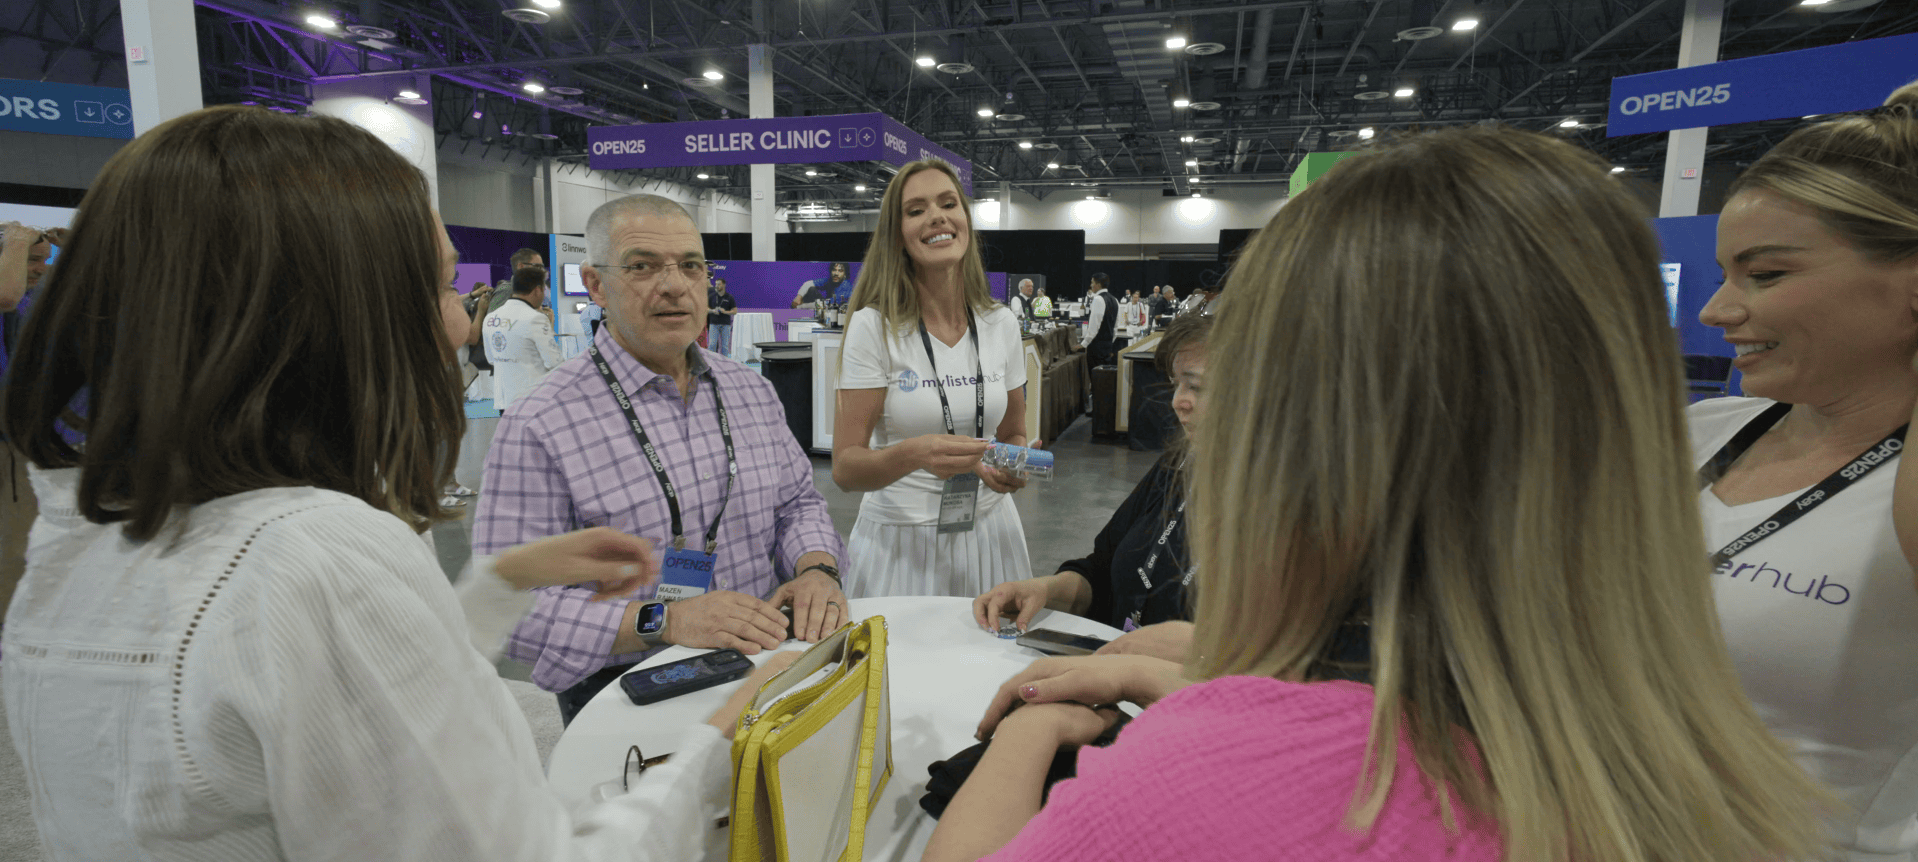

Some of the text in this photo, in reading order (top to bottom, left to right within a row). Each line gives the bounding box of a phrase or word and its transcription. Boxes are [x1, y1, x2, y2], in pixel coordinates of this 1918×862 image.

[1620, 83, 1731, 115] OPEN25
[592, 129, 831, 155] OPEN25 SELLER CLINIC
[883, 131, 907, 155] OPEN25
[486, 314, 518, 332] ebay
[773, 321, 789, 331] Thi
[921, 372, 1003, 388] mlistehub
[609, 381, 631, 410] OPEN25
[643, 442, 664, 473] OPEN25
[1722, 438, 1903, 557] OPEN25 ebay OPEN25
[1157, 520, 1177, 546] OPEN25
[665, 556, 713, 573] OPEN25
[658, 586, 683, 595] MAZEN
